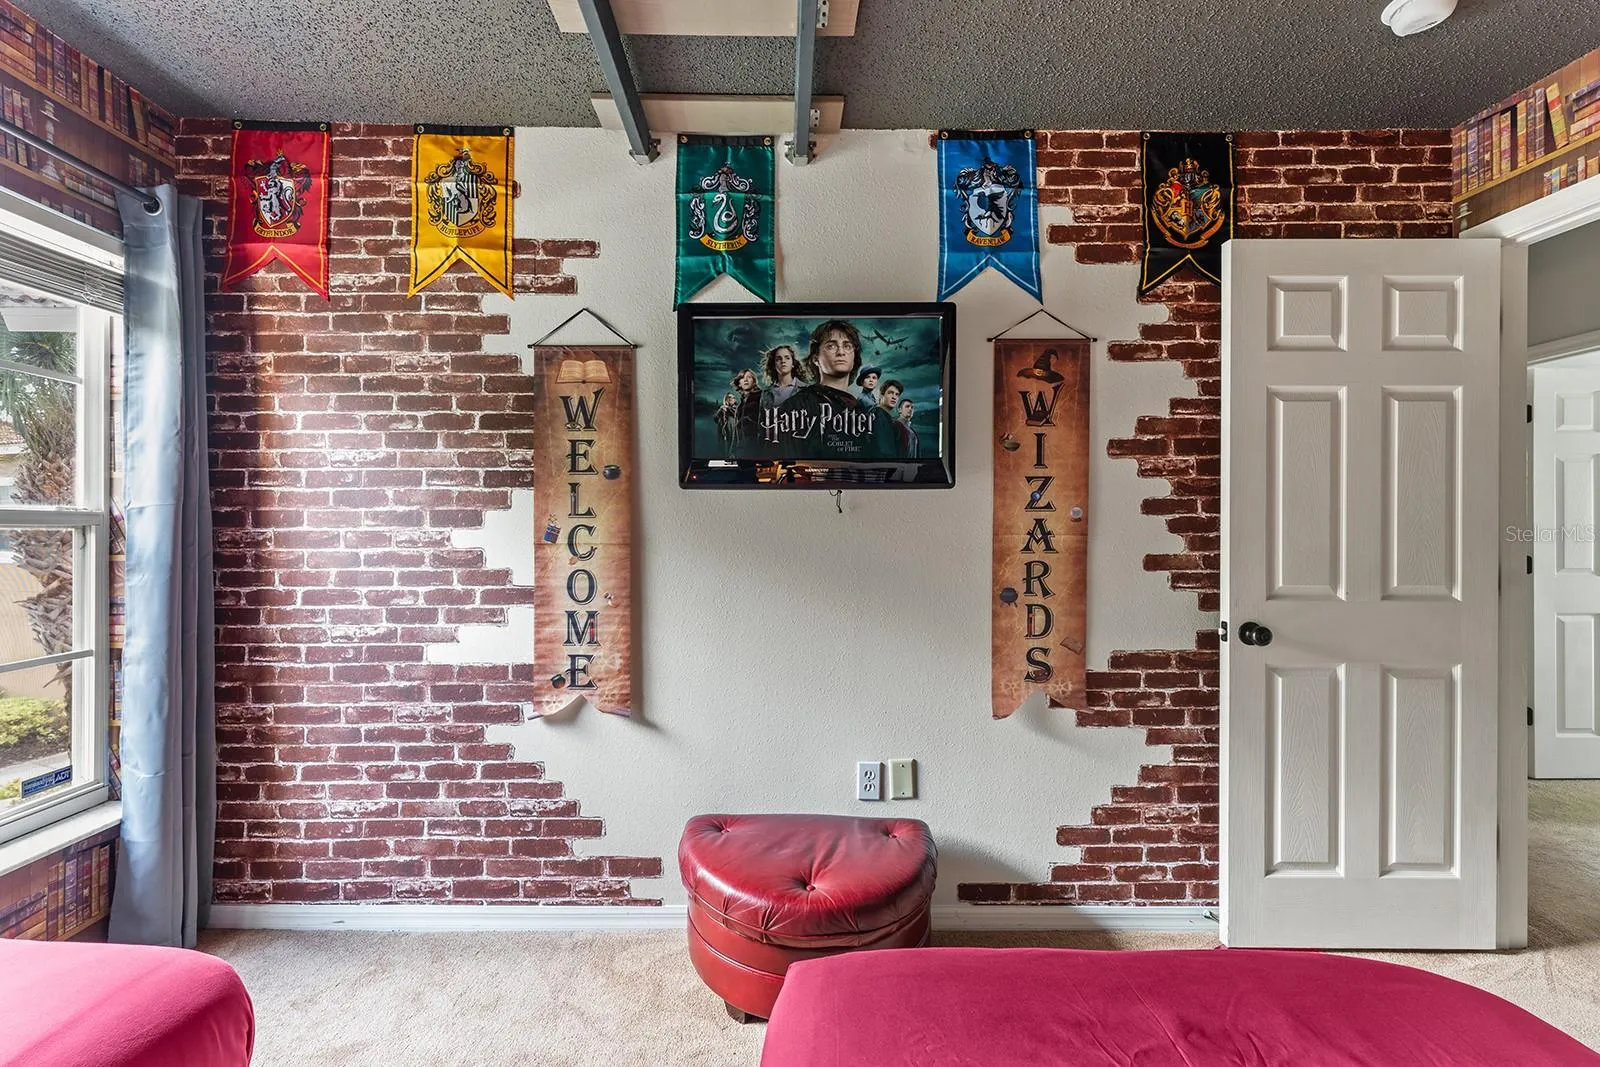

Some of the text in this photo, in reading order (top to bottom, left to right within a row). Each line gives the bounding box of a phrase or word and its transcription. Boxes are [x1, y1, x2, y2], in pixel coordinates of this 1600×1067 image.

[439, 224, 481, 236] HUFFLEPUFF
[705, 239, 742, 249] SLYTHERIN
[760, 402, 876, 443] Harry Potter
[559, 387, 605, 690] WELCOME
[1018, 383, 1064, 684] WIZARDS
